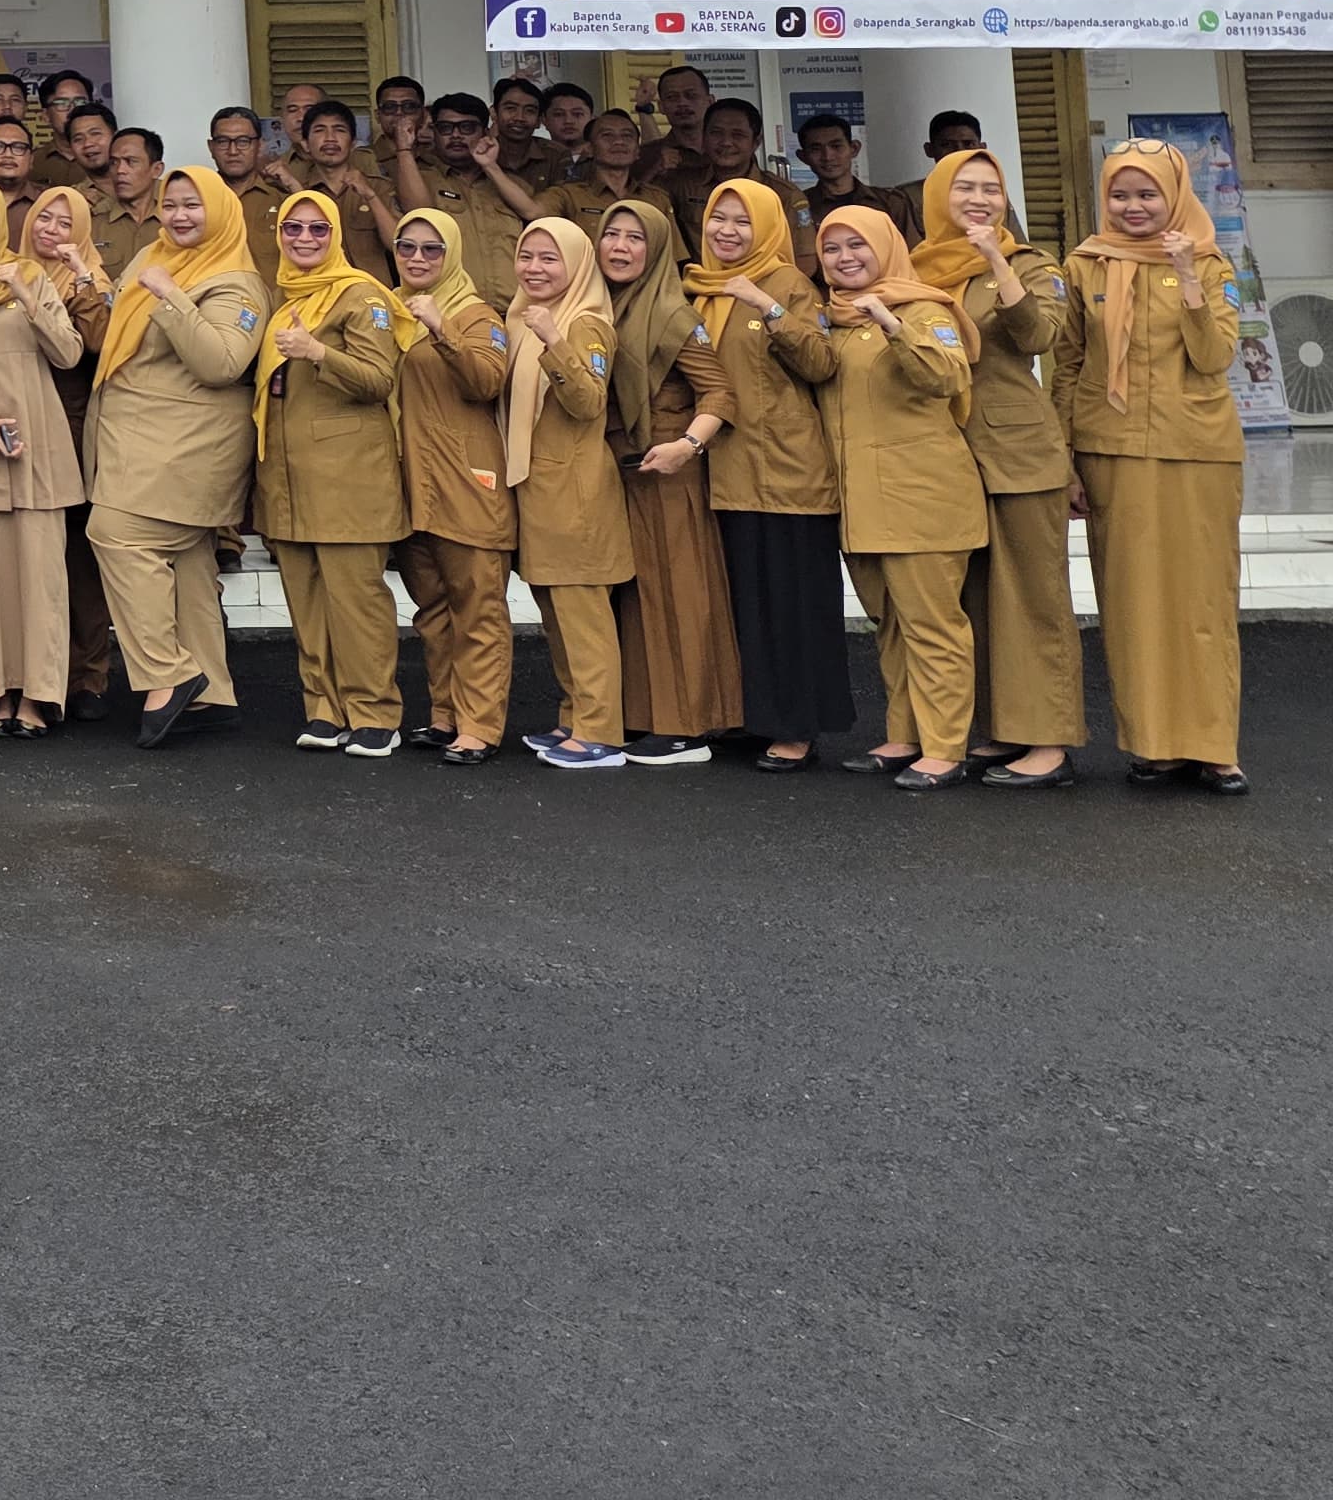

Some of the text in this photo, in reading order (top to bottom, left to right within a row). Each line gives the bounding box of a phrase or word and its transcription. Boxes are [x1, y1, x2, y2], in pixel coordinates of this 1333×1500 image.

[574, 12, 621, 23] Bapenda
[699, 11, 754, 20] BAPENDA
[1225, 11, 1273, 22] Layanan
[550, 22, 649, 34] Kabupaten Serang
[691, 22, 766, 32] KAB. SERANG
[853, 17, 976, 30] @bapenda_Serangkab
[1014, 18, 1188, 29] https://bapenda.serangkab.go.id
[1226, 27, 1306, 35] 081119135436
